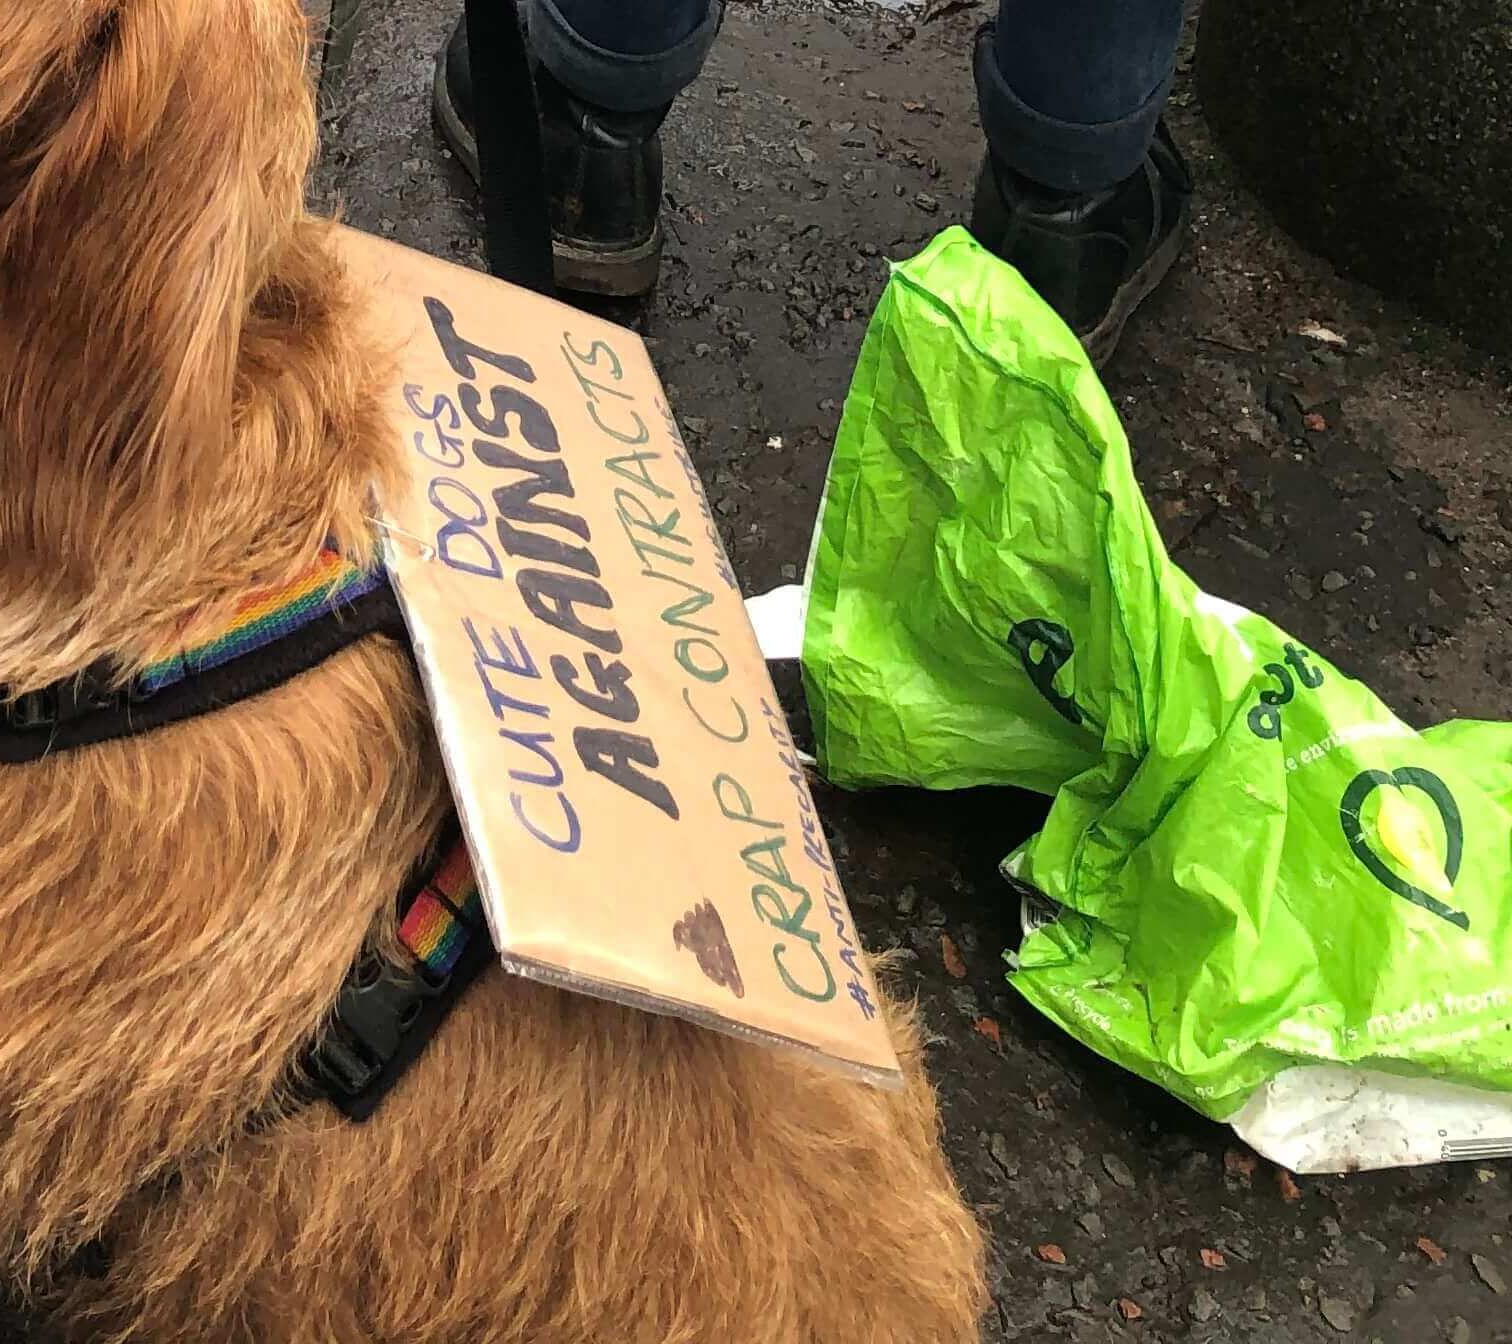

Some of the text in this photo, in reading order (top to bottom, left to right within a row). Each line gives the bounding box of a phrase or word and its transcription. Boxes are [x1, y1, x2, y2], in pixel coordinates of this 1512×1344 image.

[402, 383, 581, 853] CUTE DOGS
[422, 296, 680, 821] AGAINST
[560, 331, 837, 1003] CRAP CONTRACTS
[1366, 1000, 1437, 1039] made
